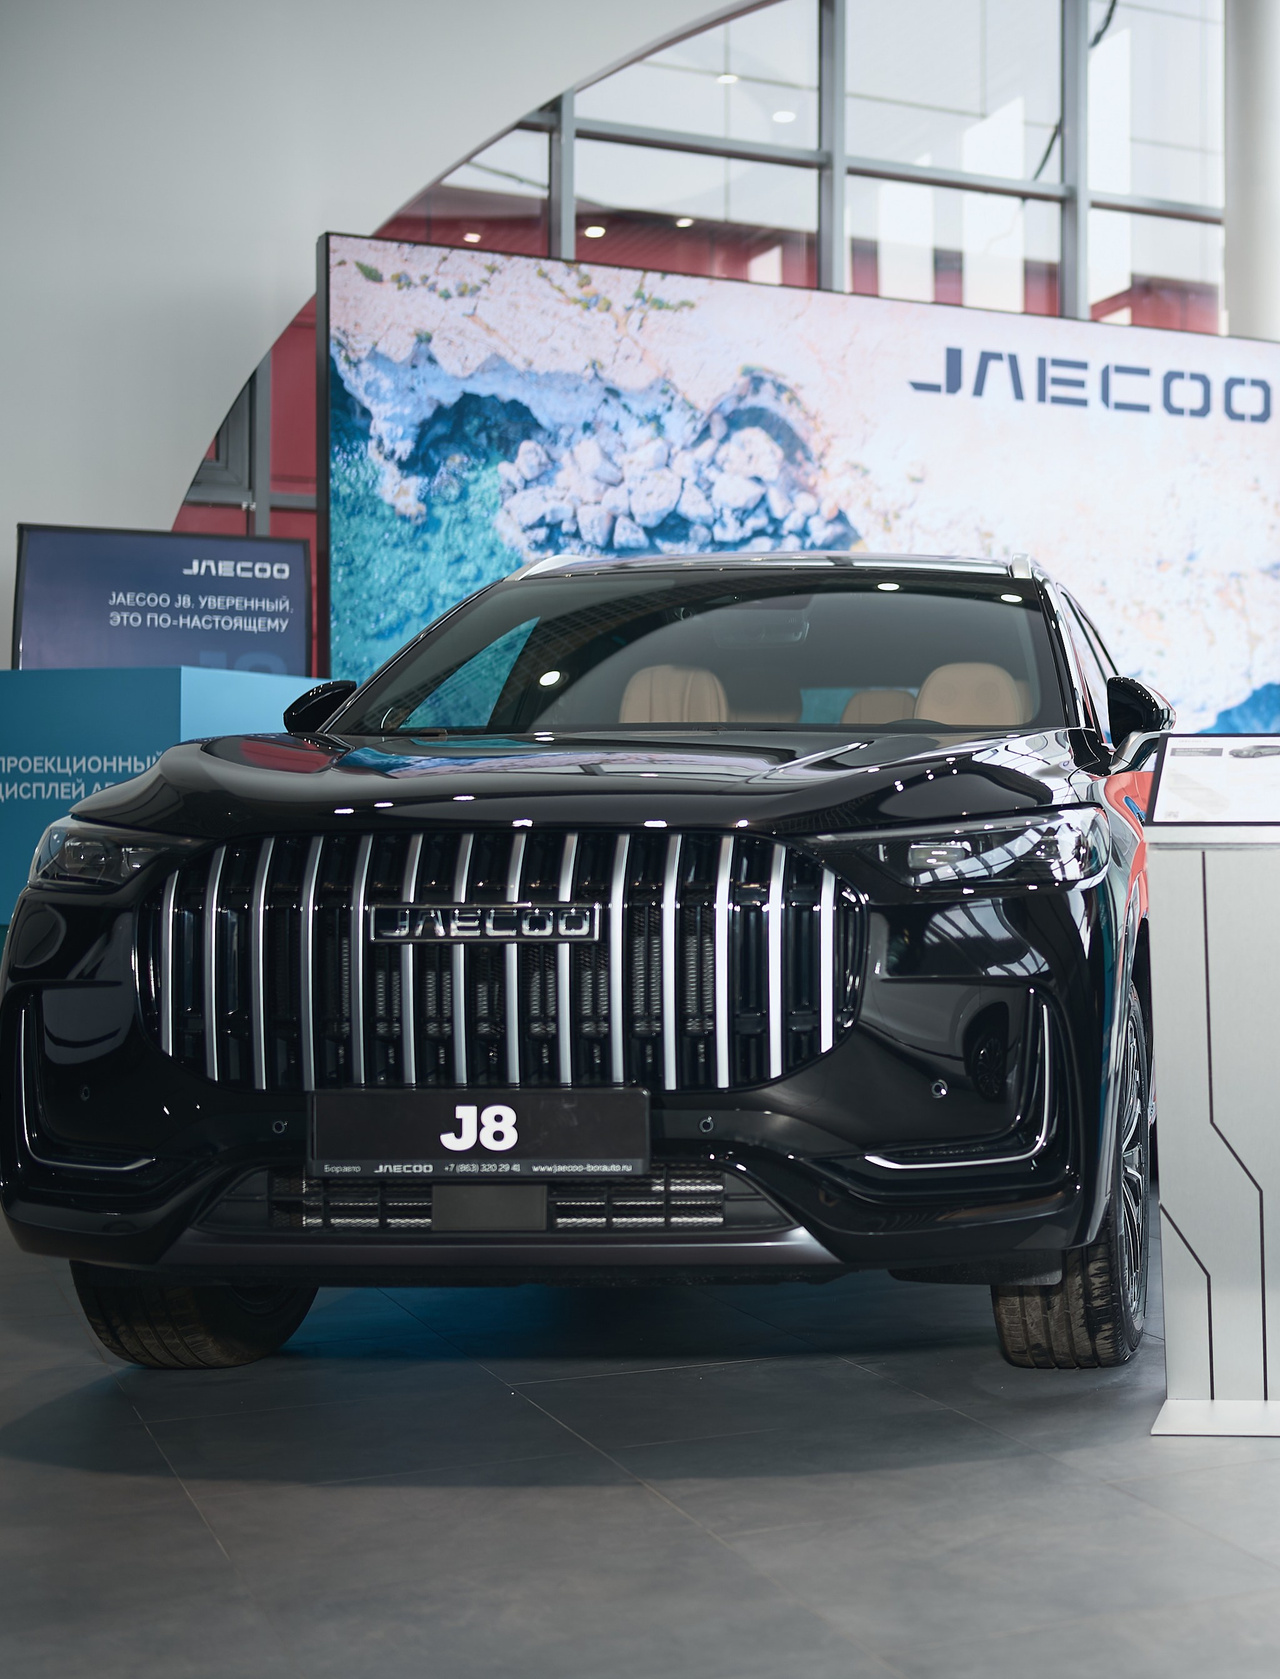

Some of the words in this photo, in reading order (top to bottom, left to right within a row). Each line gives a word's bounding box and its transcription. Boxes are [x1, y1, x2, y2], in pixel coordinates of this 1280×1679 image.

[908, 346, 1272, 424] JAECOO
[182, 559, 290, 580] JAECOO
[108, 591, 170, 608] JAECOO
[109, 611, 142, 628] ЭТО
[146, 613, 289, 634] ПО-НАСТОЯЩЕМУ
[379, 908, 590, 937] JAECOO
[439, 1104, 519, 1152] J8
[374, 1164, 434, 1173] JAECOO
[444, 1163, 455, 1172] +7
